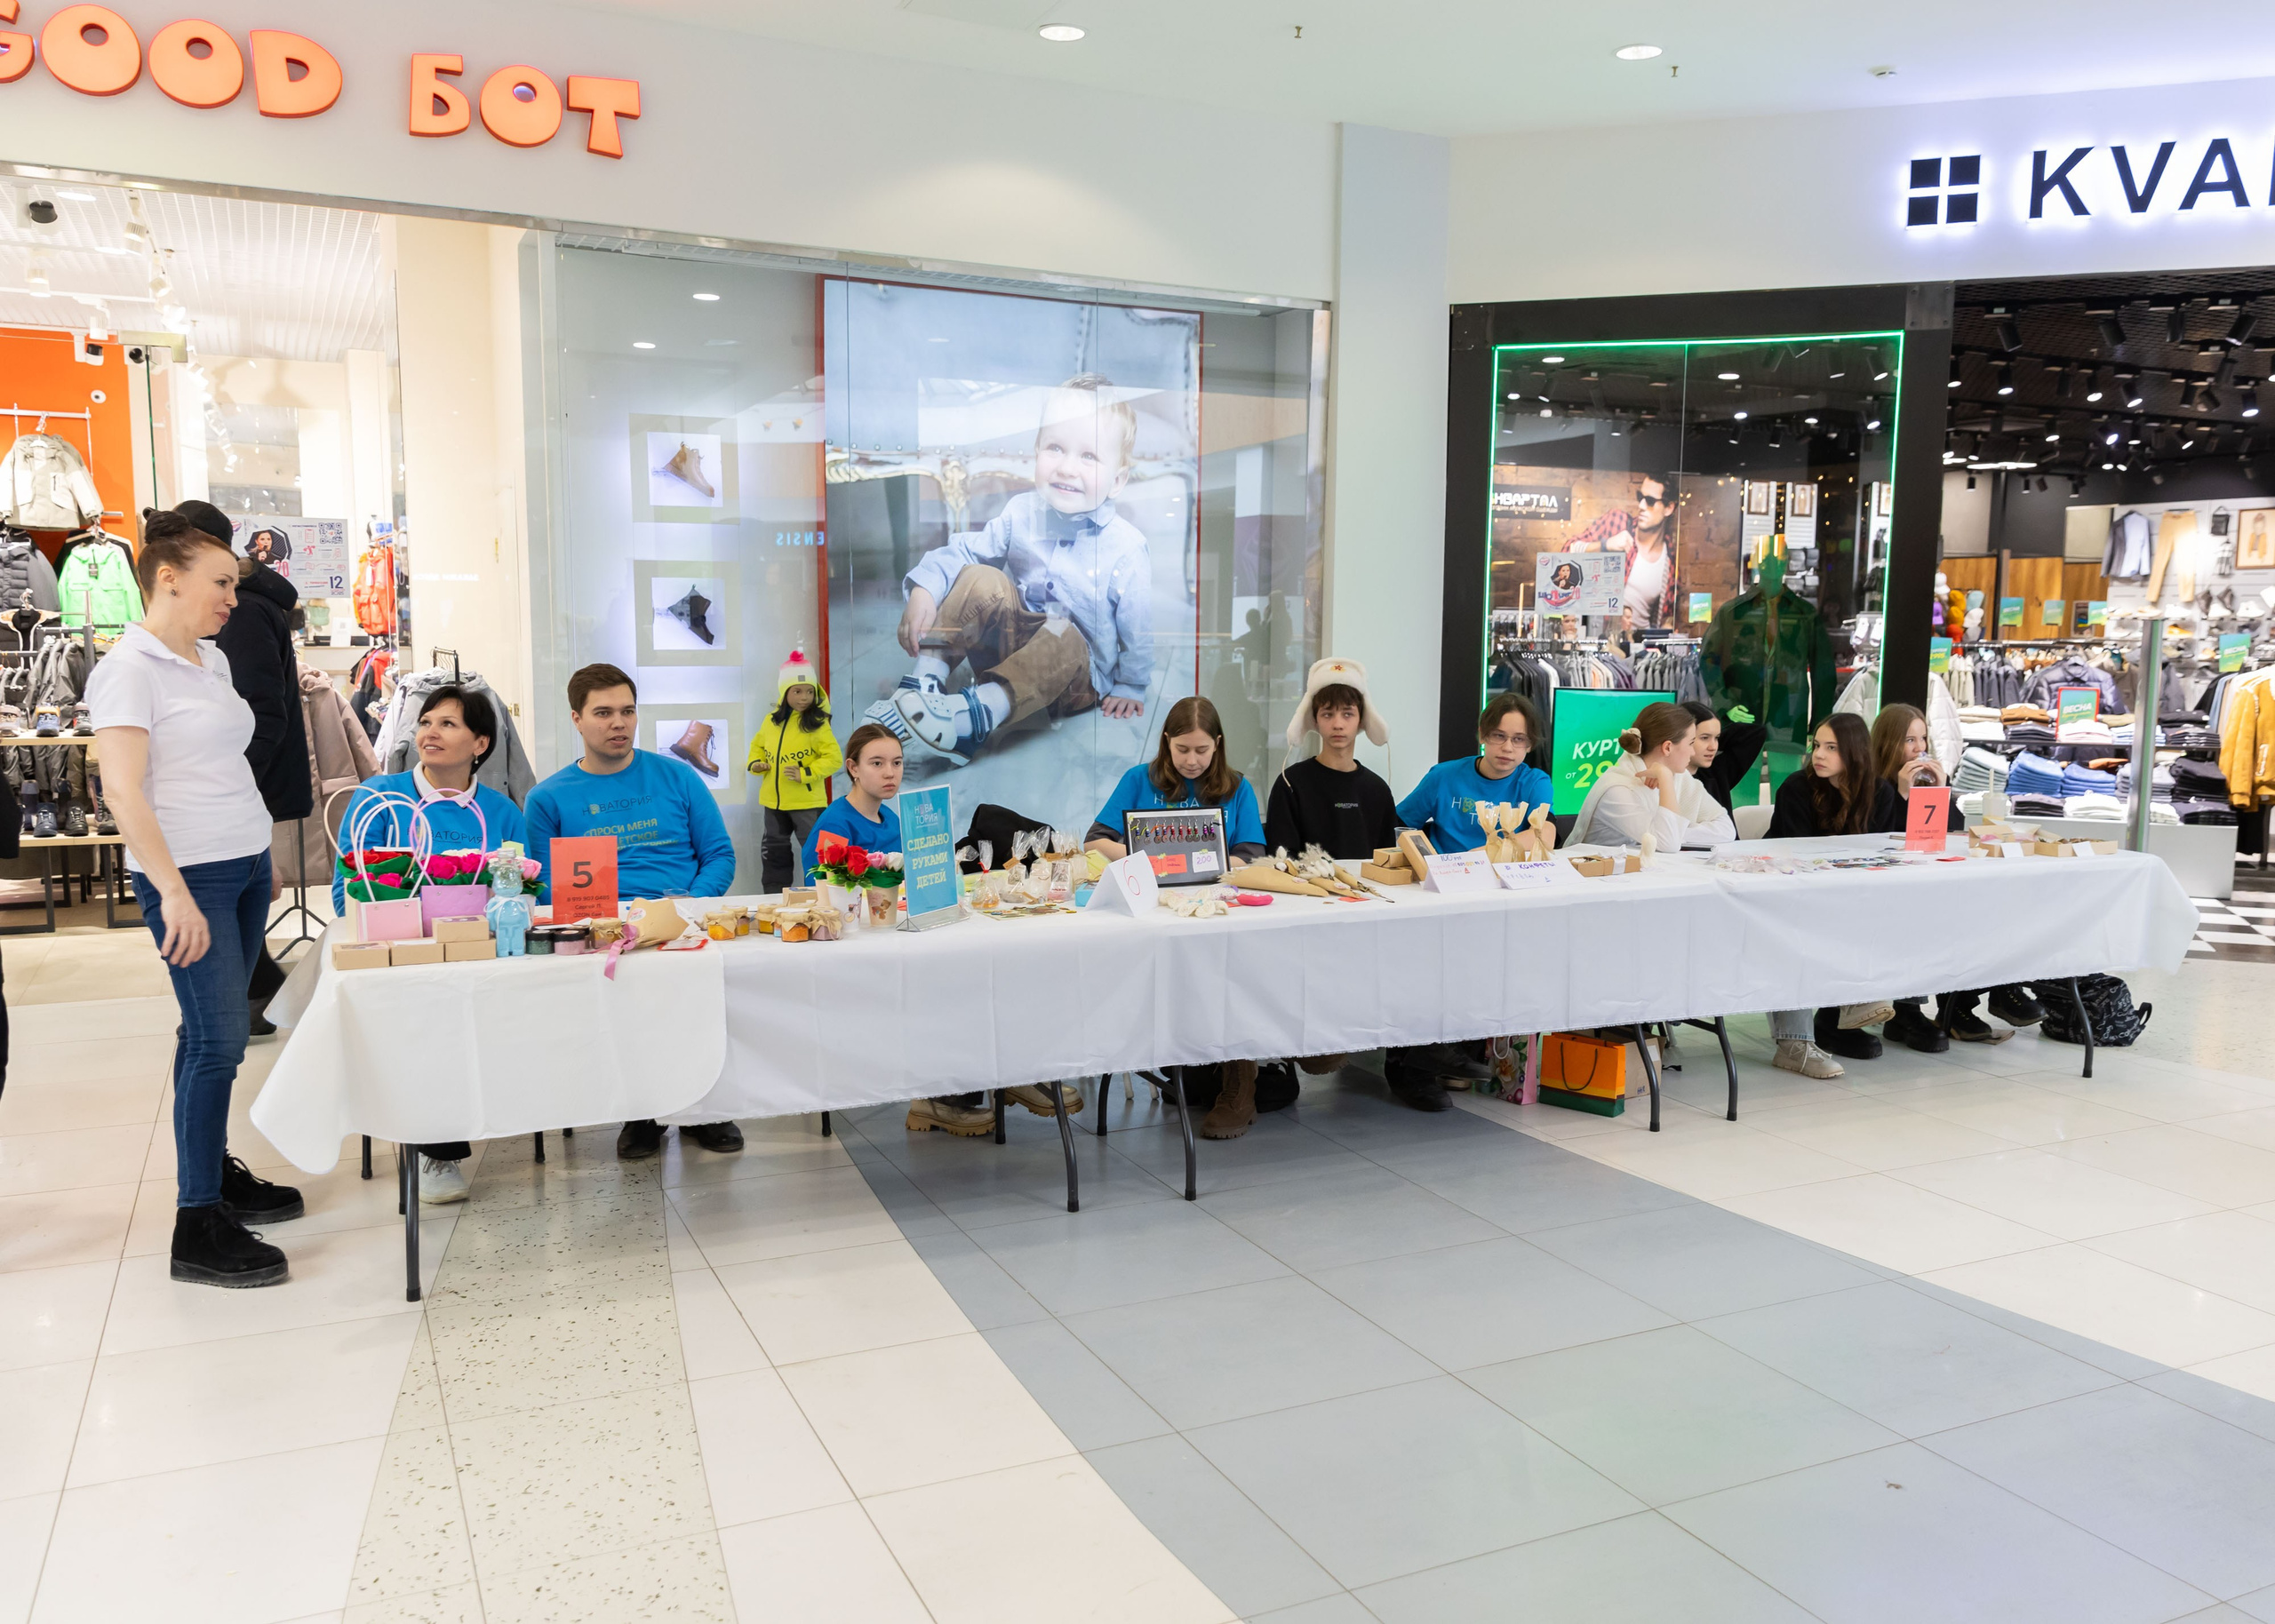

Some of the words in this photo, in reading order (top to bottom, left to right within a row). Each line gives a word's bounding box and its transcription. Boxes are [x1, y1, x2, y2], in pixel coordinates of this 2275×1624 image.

[409, 52, 642, 160] БОТ
[2030, 135, 2275, 219] KVA
[329, 576, 344, 589] 12
[1608, 598, 1618, 608] 12
[2063, 703, 2092, 714] ВЕСНА
[1572, 738, 1620, 760] КУРТ
[915, 812, 938, 824] ТОРИЯ
[1924, 805, 1936, 824] 7
[627, 817, 658, 832] МЕНЯ
[619, 830, 659, 846] ЕТСКОЕ
[906, 832, 950, 852] СДЕЛАНО
[912, 851, 948, 870] РУКАМИ
[1196, 855, 1212, 865] 200
[572, 861, 593, 888] 5
[916, 868, 946, 889] ДЕТЕЙ
[1122, 859, 1141, 896] 6
